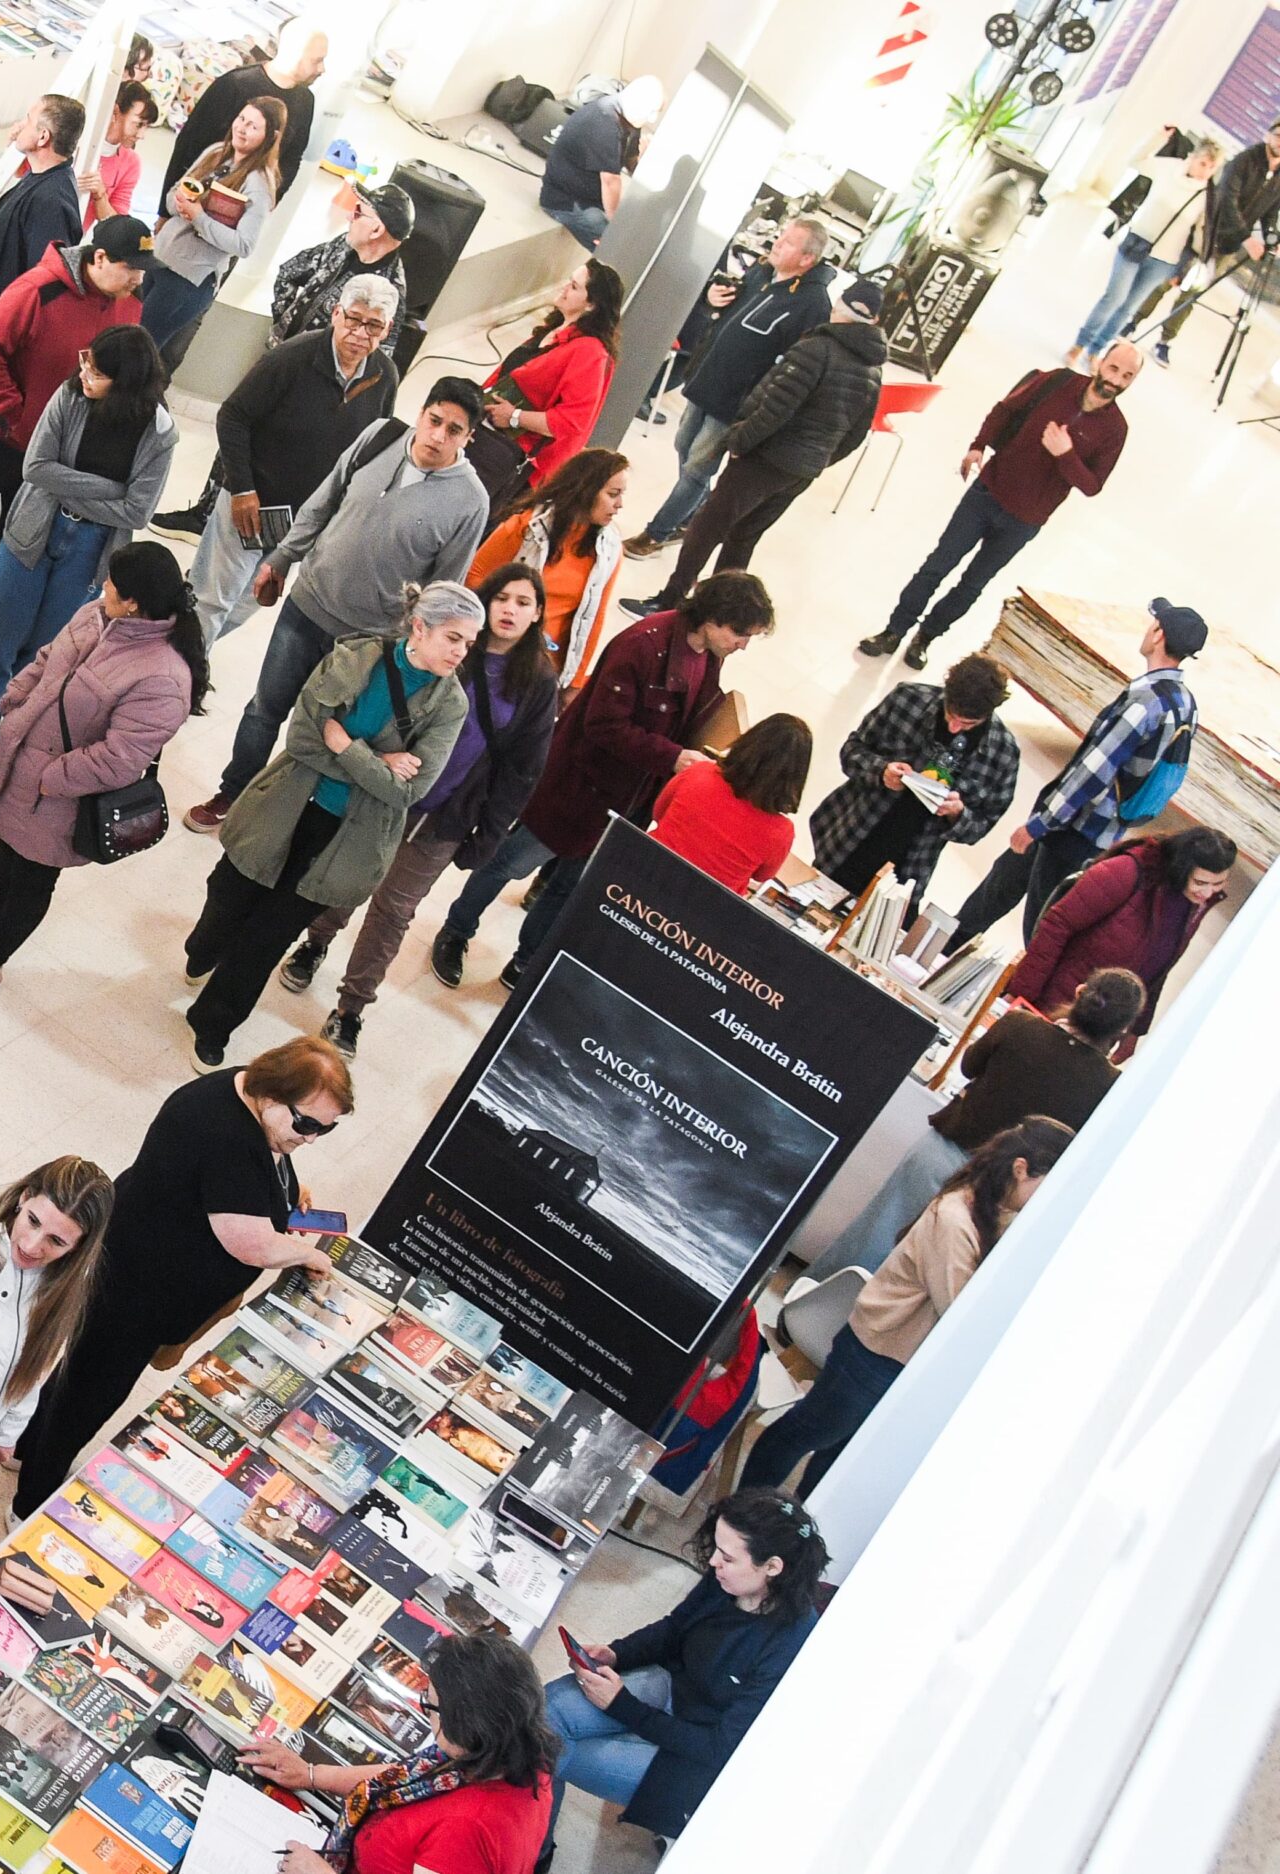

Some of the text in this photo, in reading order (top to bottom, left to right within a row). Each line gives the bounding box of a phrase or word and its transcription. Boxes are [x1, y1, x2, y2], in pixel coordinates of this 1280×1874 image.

[598, 903, 728, 995] GALESES DE LA PATAGONIA
[605, 883, 785, 1011] CANCIÓN INTERIOR
[709, 1007, 843, 1104] Alejandra Brátin
[580, 1036, 749, 1160] CANCIÓN INTERIOR
[594, 1068, 714, 1154] GALESES DE LA PATAGONIA
[448, 1208, 482, 1241] libro
[482, 1231, 503, 1254] de
[534, 1202, 613, 1263] Alejandra Brátin
[388, 1241, 421, 1270] de estos
[401, 1219, 415, 1233] La
[414, 1227, 439, 1251] trama
[438, 1245, 452, 1258] de
[450, 1254, 464, 1268] un
[495, 1286, 507, 1299] su
[415, 1214, 436, 1232] Con
[435, 1226, 471, 1256] historias
[517, 1287, 532, 1300] de
[529, 1295, 575, 1333] generación
[574, 1328, 588, 1341] en
[401, 1234, 430, 1257] Entrar
[429, 1253, 442, 1266] en
[441, 1262, 455, 1277] sus
[518, 1319, 543, 1342] sentir
[540, 1337, 550, 1346] y
[577, 1363, 594, 1378] son
[592, 1372, 604, 1385] la
[241, 1396, 274, 1429] BONELLI
[204, 1424, 229, 1449] ALLENDE
[215, 1431, 235, 1452] ISABEL
[357, 1539, 387, 1570] LOCA
[71, 1682, 106, 1718] ANDAHAZI
[80, 1688, 113, 1724] FEDERICO
[69, 1746, 104, 1784] FEDERICO
[154, 1770, 178, 1795] Fitzek
[30, 1771, 68, 1815] BALMACEDA
